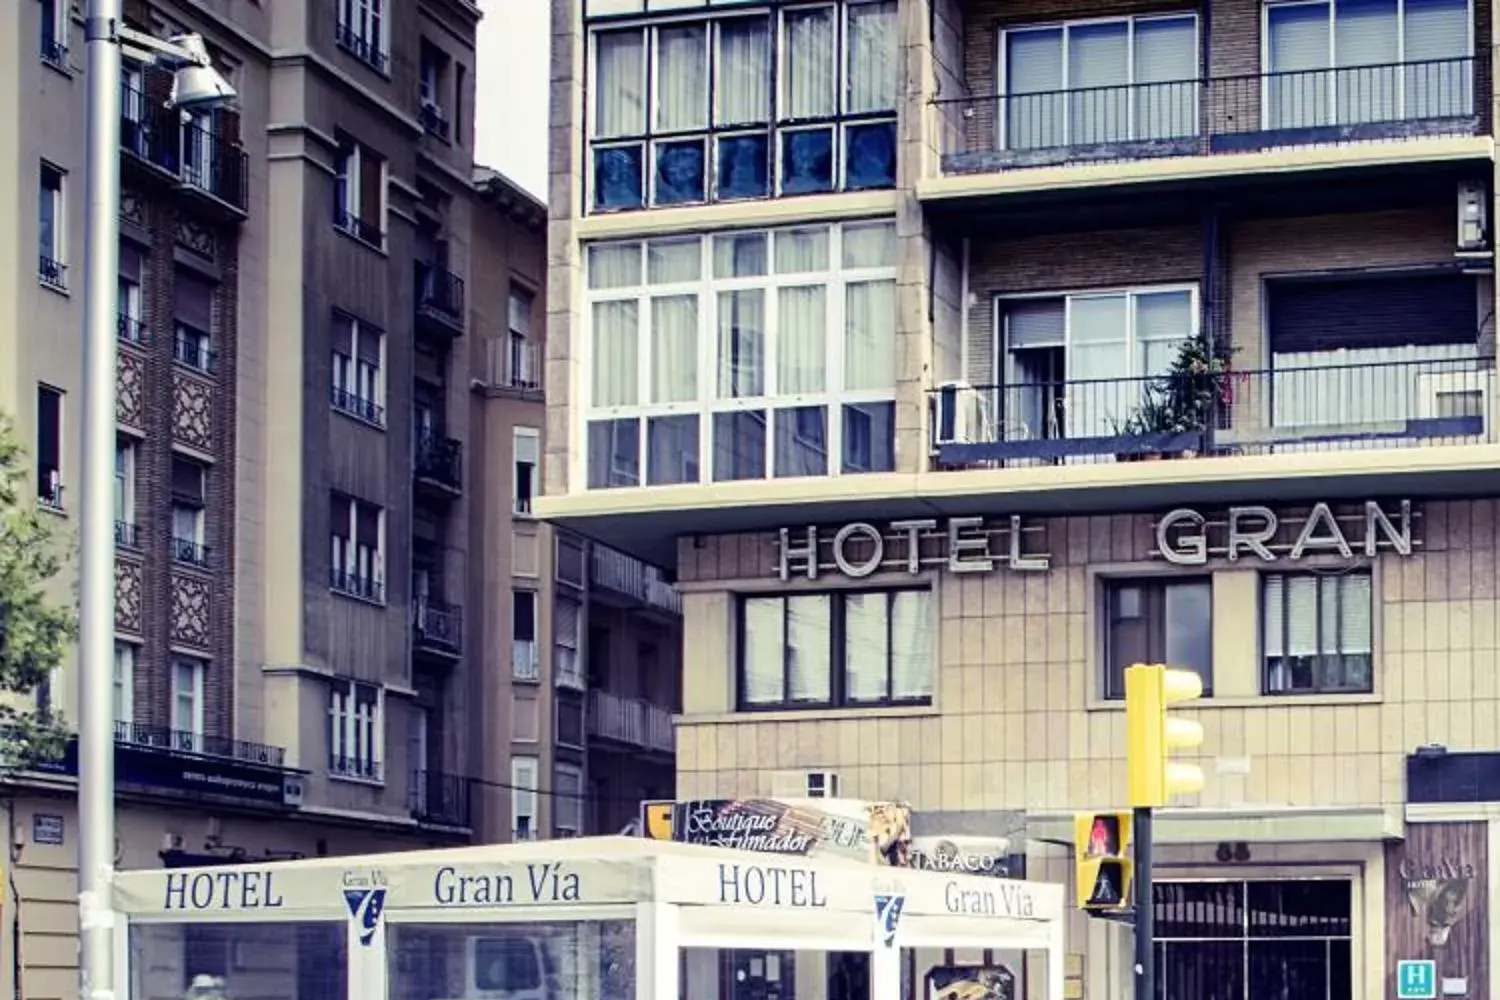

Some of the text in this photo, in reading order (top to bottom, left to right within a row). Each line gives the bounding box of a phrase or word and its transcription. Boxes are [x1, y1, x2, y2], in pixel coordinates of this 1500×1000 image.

[779, 515, 1049, 581] HOTEL
[1157, 499, 1412, 564] GRAN
[164, 862, 581, 909] HOTEL Gran Vía
[718, 863, 827, 907] HOTEL
[944, 881, 996, 916] Gran
[1001, 883, 1034, 917] Vía
[1407, 965, 1426, 985] H
